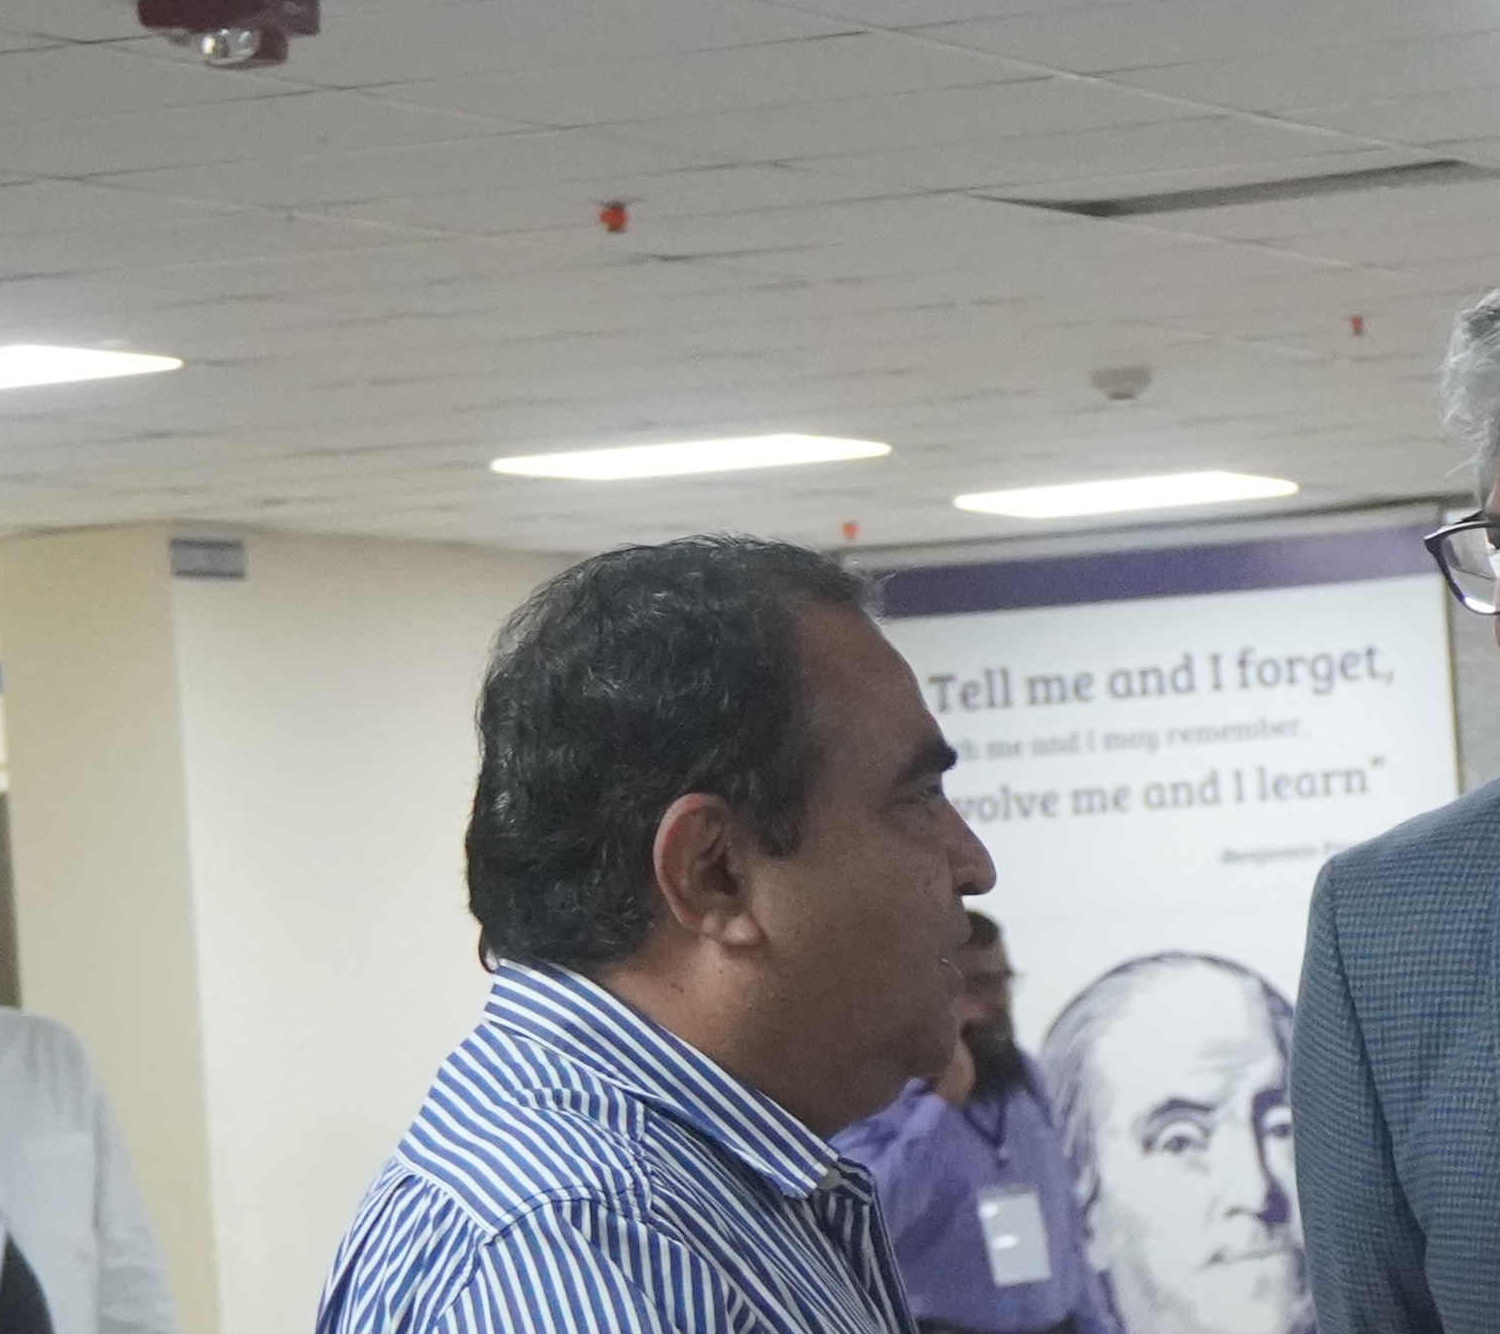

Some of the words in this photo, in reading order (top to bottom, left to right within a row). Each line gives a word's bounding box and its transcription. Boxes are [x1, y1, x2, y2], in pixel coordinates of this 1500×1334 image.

[1025, 670, 1095, 707] me
[1107, 652, 1195, 698] and
[1210, 653, 1223, 692] I
[1237, 646, 1394, 697] forget,
[1071, 784, 1132, 816] me
[1141, 769, 1222, 809] and
[1233, 769, 1245, 803] I
